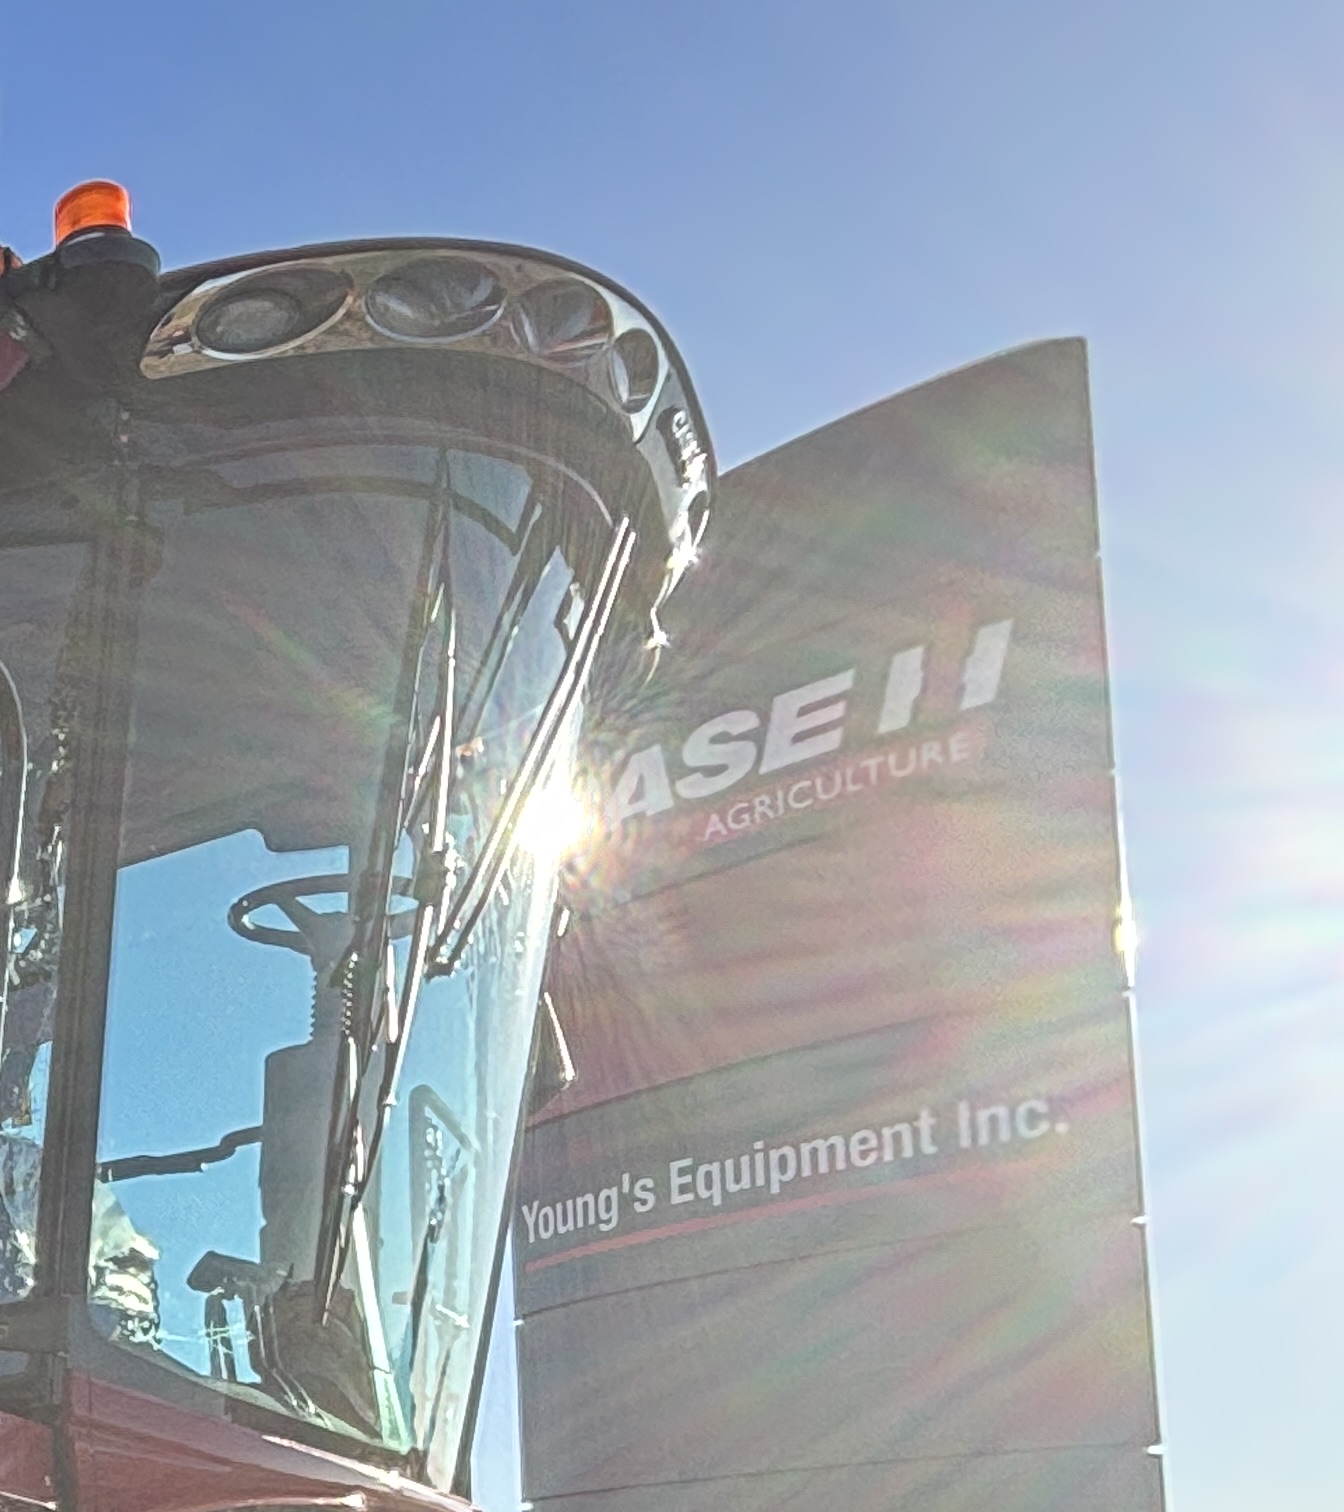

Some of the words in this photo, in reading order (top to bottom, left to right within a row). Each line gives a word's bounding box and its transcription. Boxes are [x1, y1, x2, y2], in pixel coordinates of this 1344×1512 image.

[608, 667, 856, 822] ASE
[701, 731, 970, 843] AGRICULTURE
[521, 1172, 657, 1244] Young's
[669, 1109, 939, 1207] Equipment
[958, 1098, 1070, 1149] Inc.
